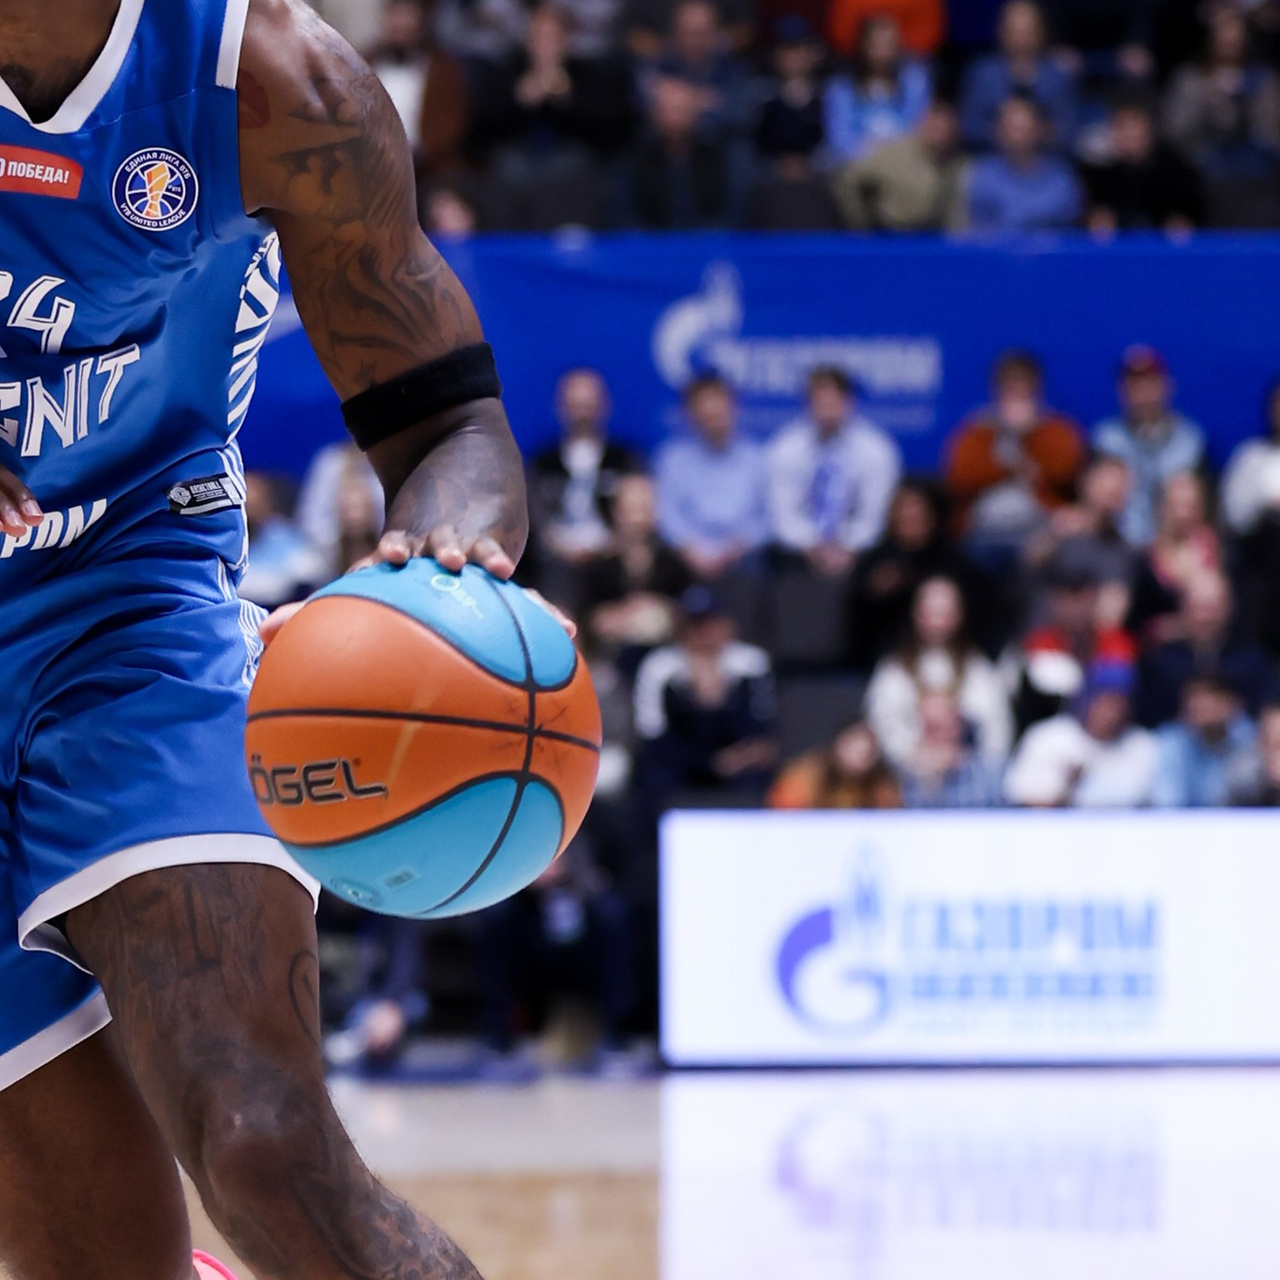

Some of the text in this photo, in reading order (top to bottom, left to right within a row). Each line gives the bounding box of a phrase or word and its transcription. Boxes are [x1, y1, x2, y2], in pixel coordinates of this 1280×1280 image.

[7, 160, 69, 184] ПОБЕДА!
[124, 152, 158, 173] ЕДИНАЯ
[158, 152, 180, 167] ЛИГА
[120, 202, 187, 227] VTB UNITED LEAGUE
[251, 753, 388, 806] ÖGEL
